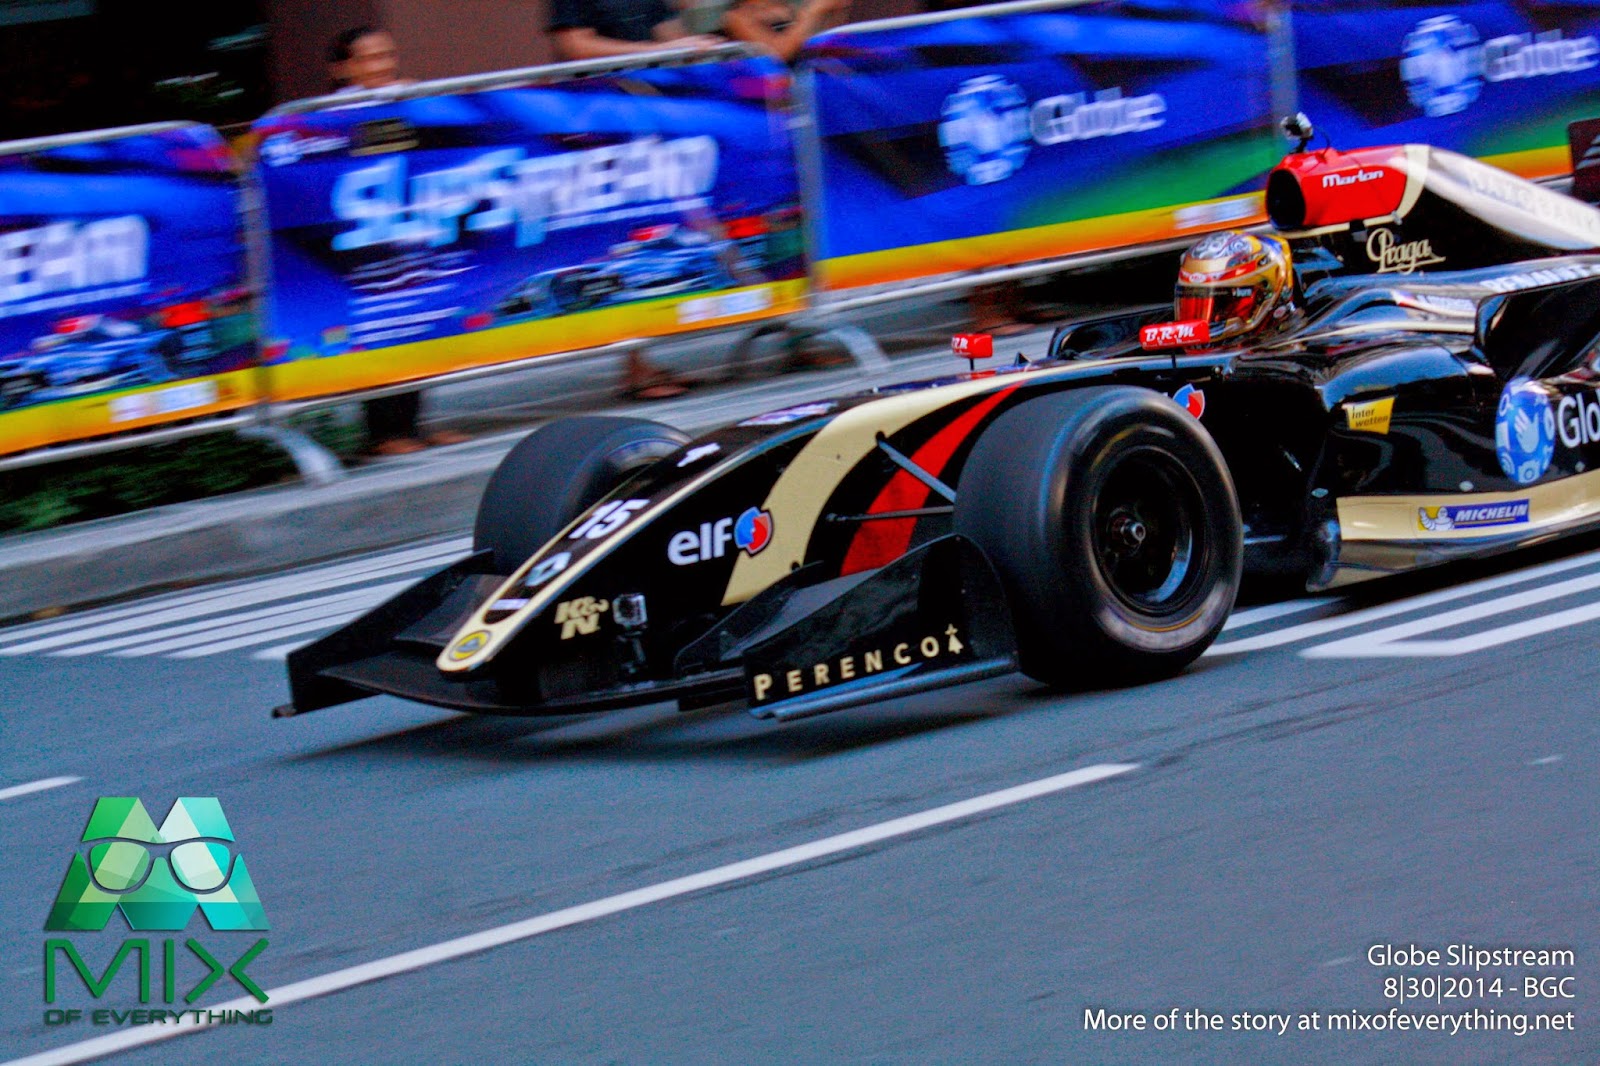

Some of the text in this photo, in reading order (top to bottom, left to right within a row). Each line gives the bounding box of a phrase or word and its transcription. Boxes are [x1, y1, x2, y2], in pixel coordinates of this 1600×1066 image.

[1030, 86, 1166, 146] Globe
[1322, 169, 1384, 188] Marlon
[1366, 228, 1447, 275] Praga
[1557, 391, 1600, 448] Glo
[568, 498, 650, 539] 15
[1455, 504, 1528, 521] MICHELIN
[667, 517, 733, 566] elf
[754, 636, 940, 701] PERENCO
